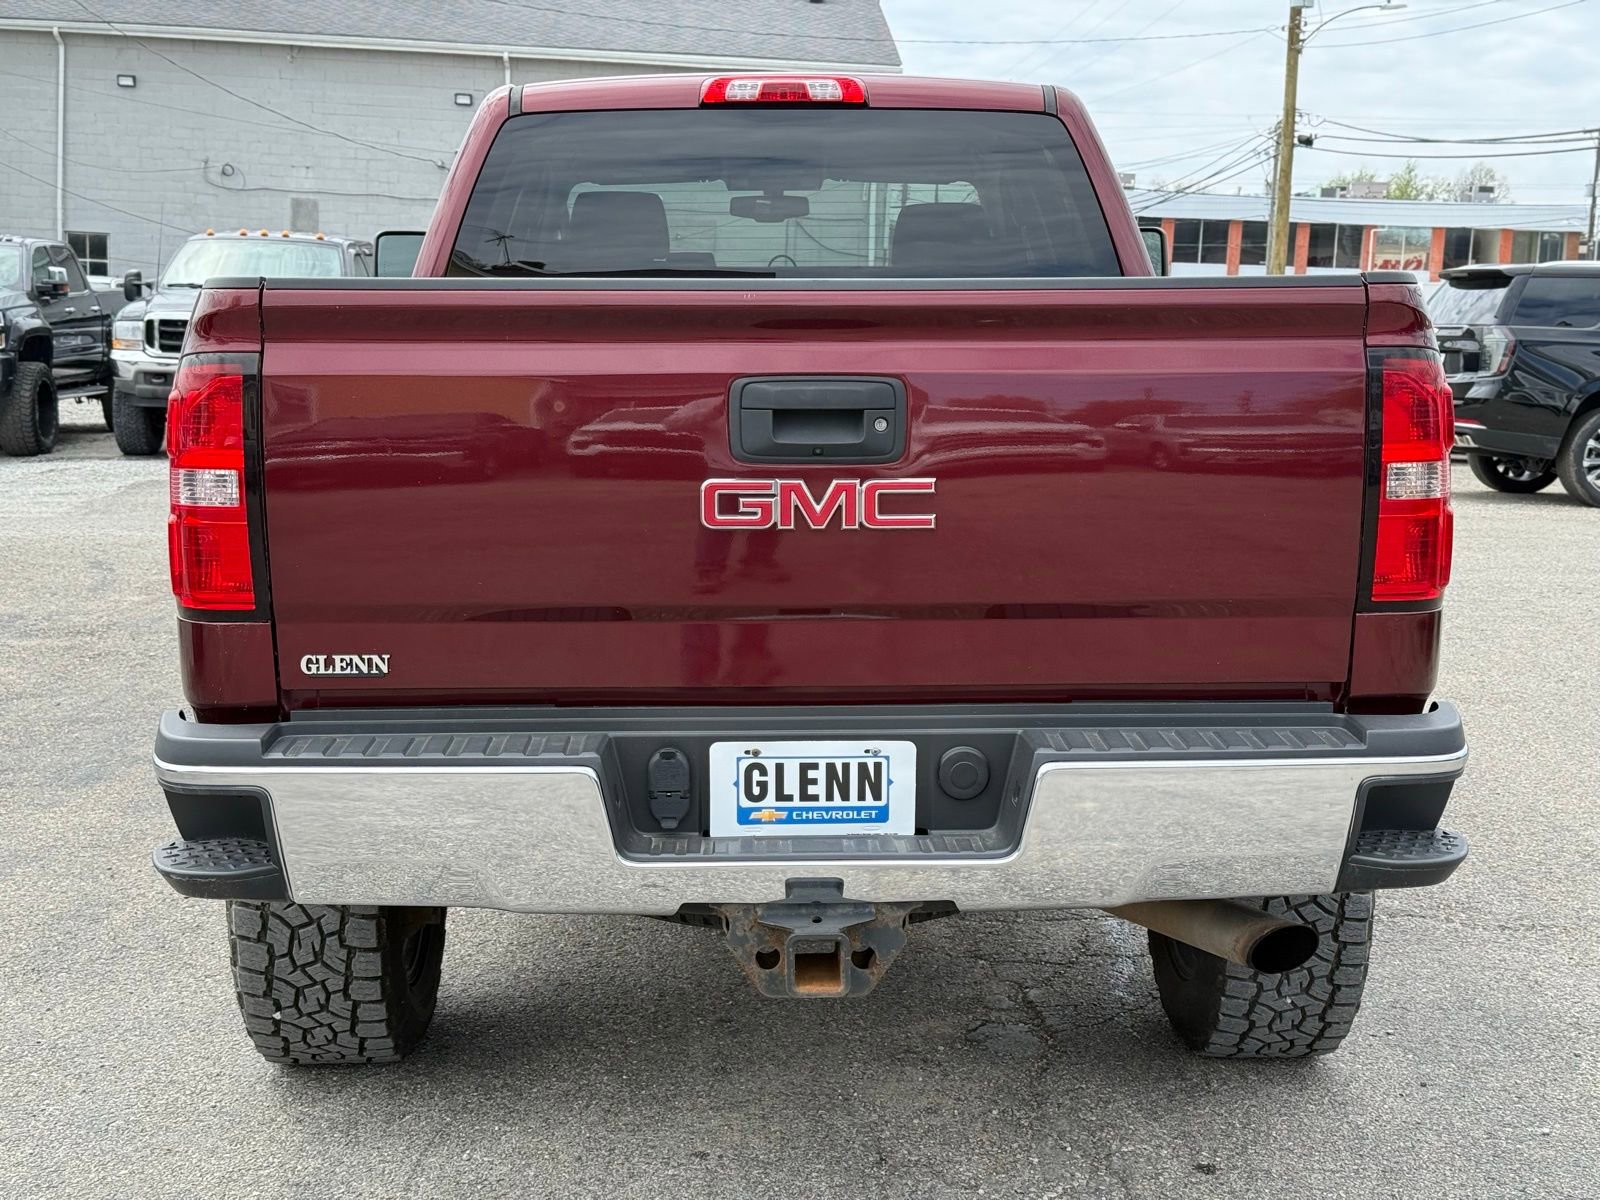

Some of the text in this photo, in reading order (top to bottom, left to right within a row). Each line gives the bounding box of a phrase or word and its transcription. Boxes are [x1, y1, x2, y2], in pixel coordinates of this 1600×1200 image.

[700, 477, 937, 530] GMC
[300, 654, 391, 676] GLENN
[743, 761, 883, 803] GLENN
[792, 810, 879, 820] CHEVROLET
